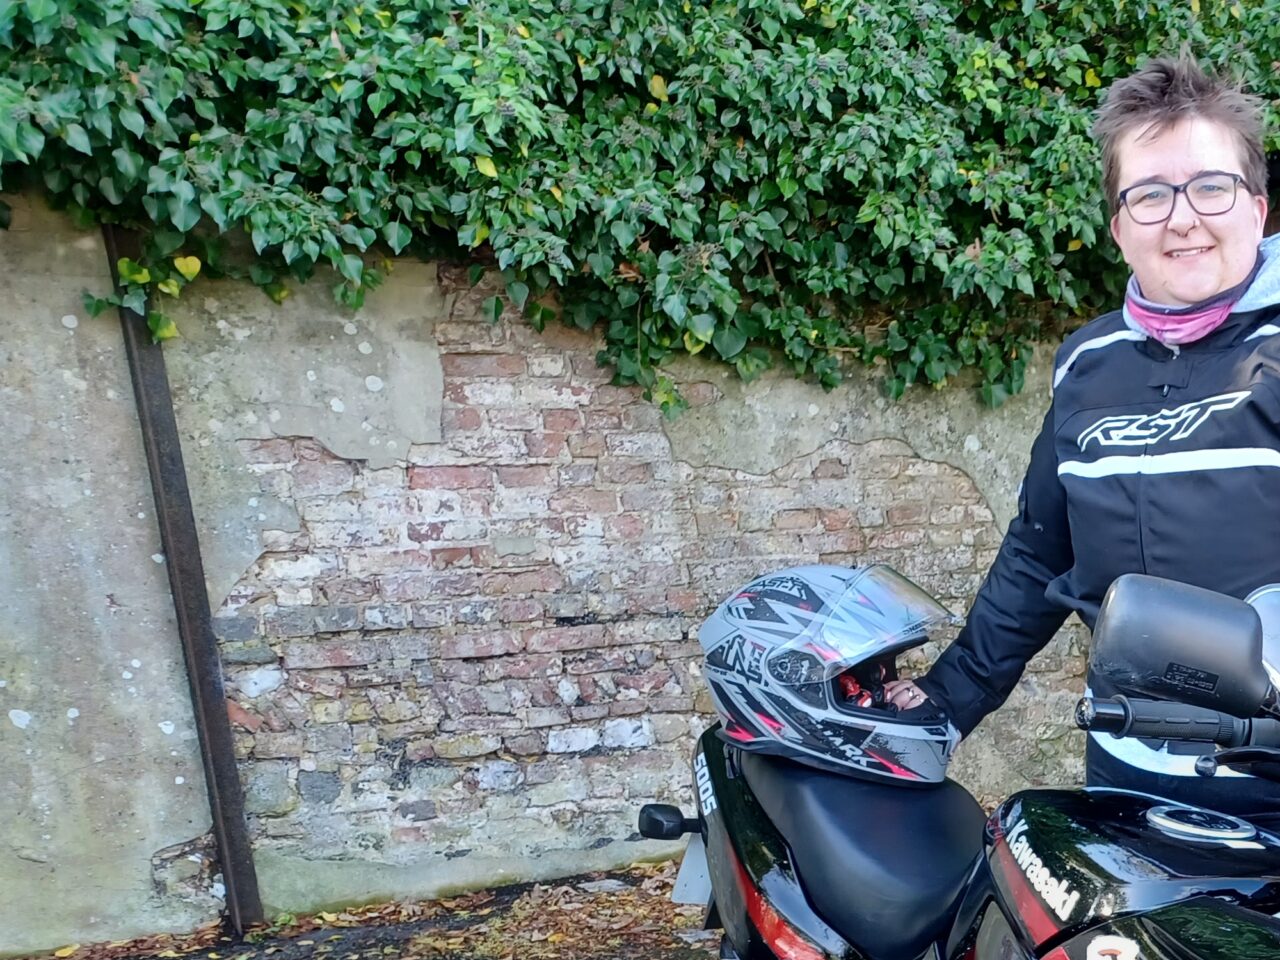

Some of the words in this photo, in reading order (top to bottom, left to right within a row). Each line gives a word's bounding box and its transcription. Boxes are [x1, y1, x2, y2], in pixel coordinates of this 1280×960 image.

[1077, 390, 1252, 453] RST
[807, 715, 882, 768] ARK
[1005, 819, 1080, 922] Kawasaki
